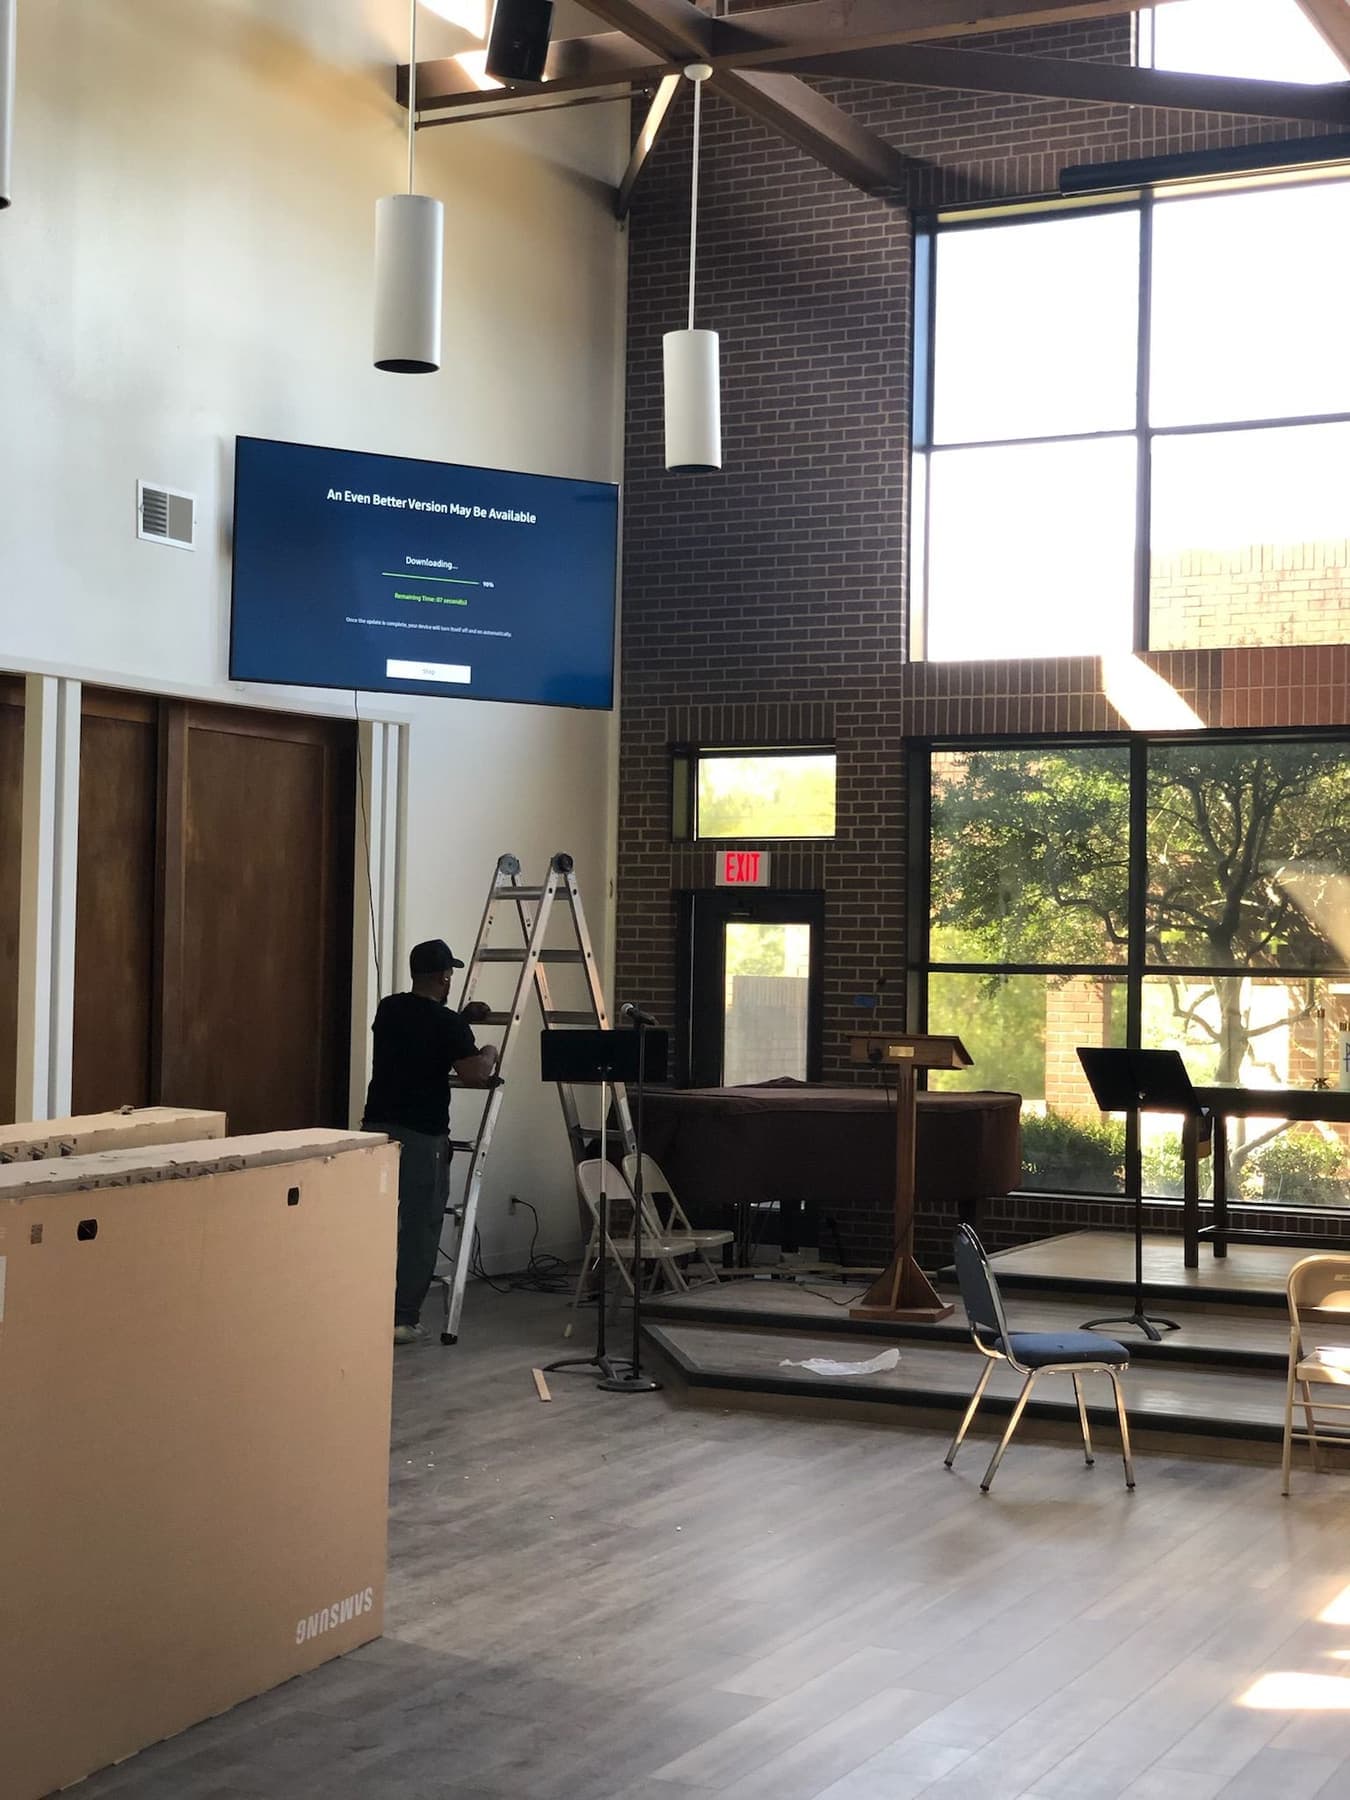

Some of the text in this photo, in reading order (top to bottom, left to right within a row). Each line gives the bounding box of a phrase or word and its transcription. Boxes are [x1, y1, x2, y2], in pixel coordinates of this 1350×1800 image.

[326, 488, 537, 524] An Even Better Version May Be Available
[725, 852, 761, 883] EXIT
[295, 1586, 374, 1645] SAMSUNG
